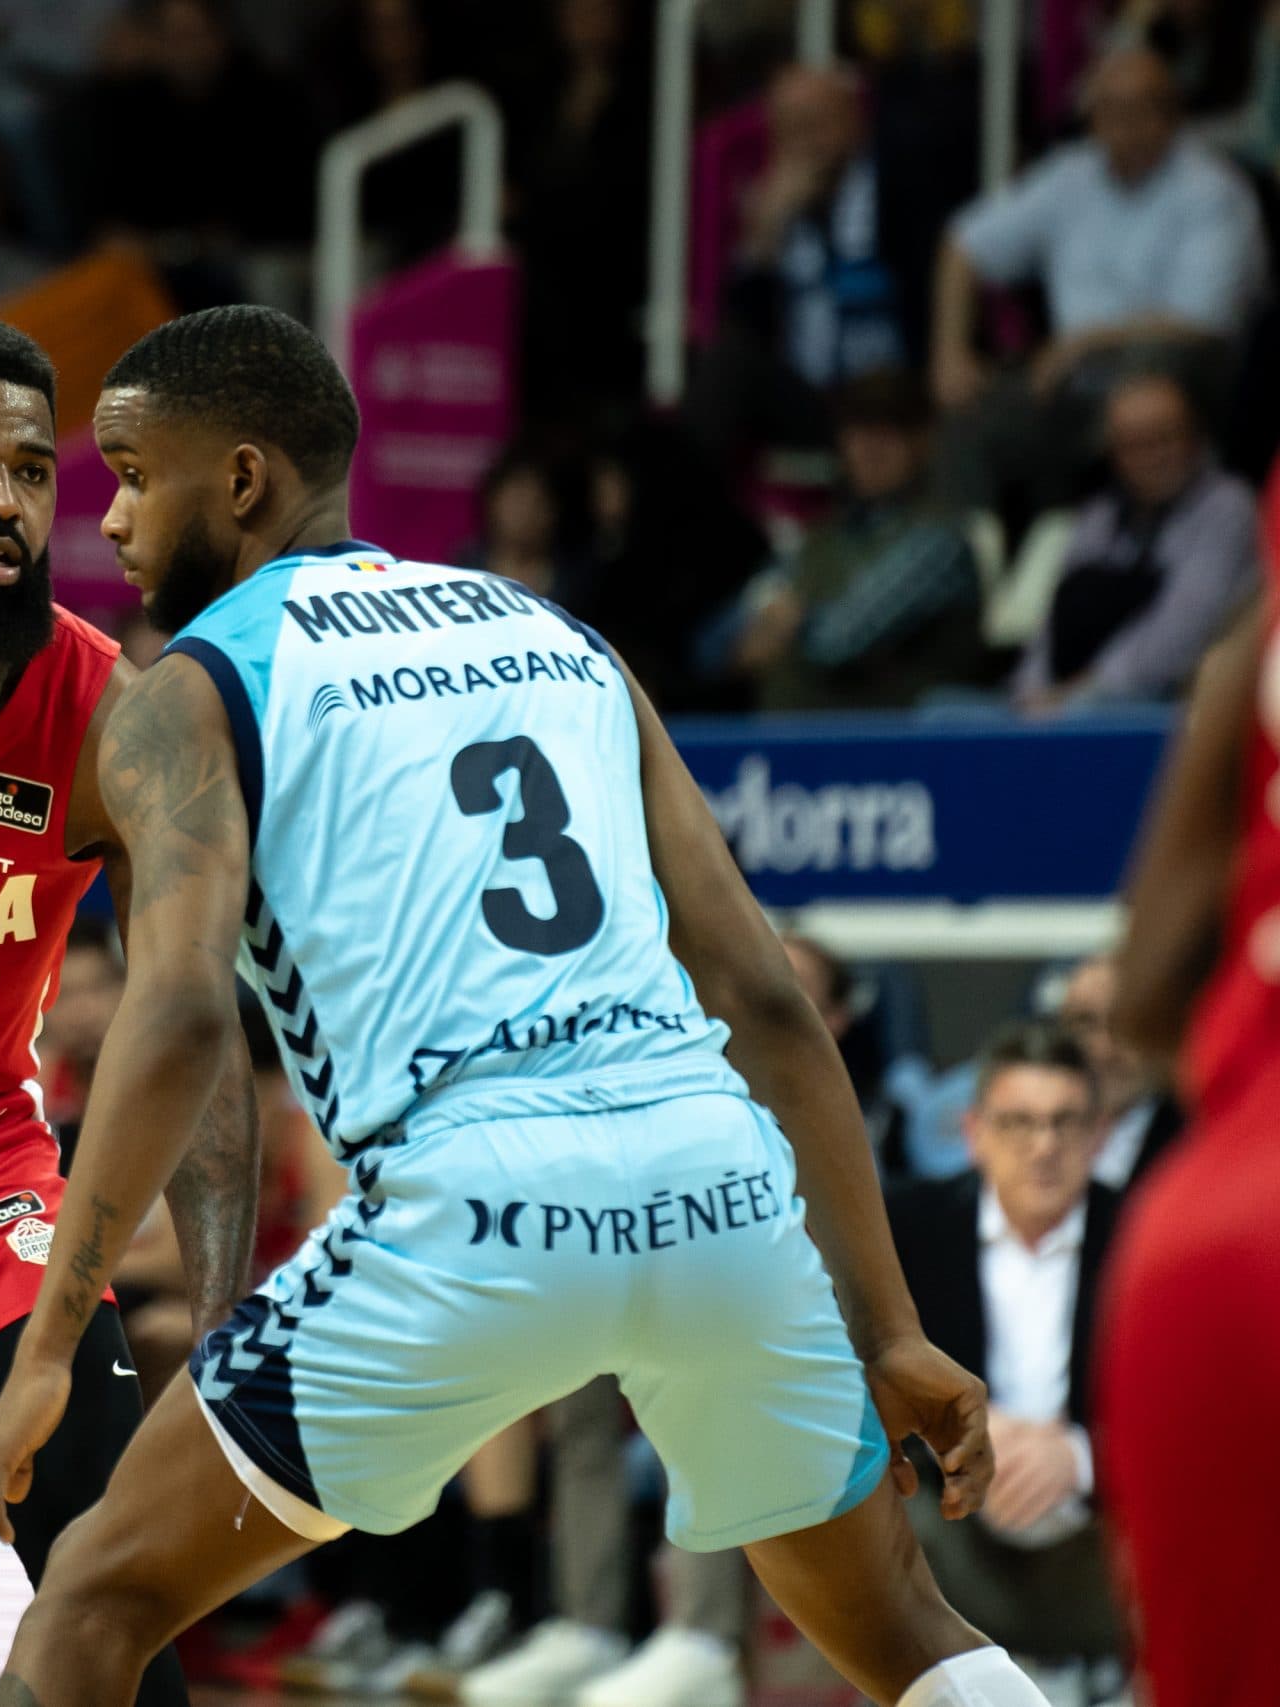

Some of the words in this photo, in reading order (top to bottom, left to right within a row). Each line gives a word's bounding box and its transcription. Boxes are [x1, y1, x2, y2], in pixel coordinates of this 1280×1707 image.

[282, 576, 534, 643] MONTERO
[350, 650, 606, 710] MORABANC
[450, 735, 606, 958] 3
[702, 754, 934, 873] dorra
[19, 1241, 49, 1259] GIRO
